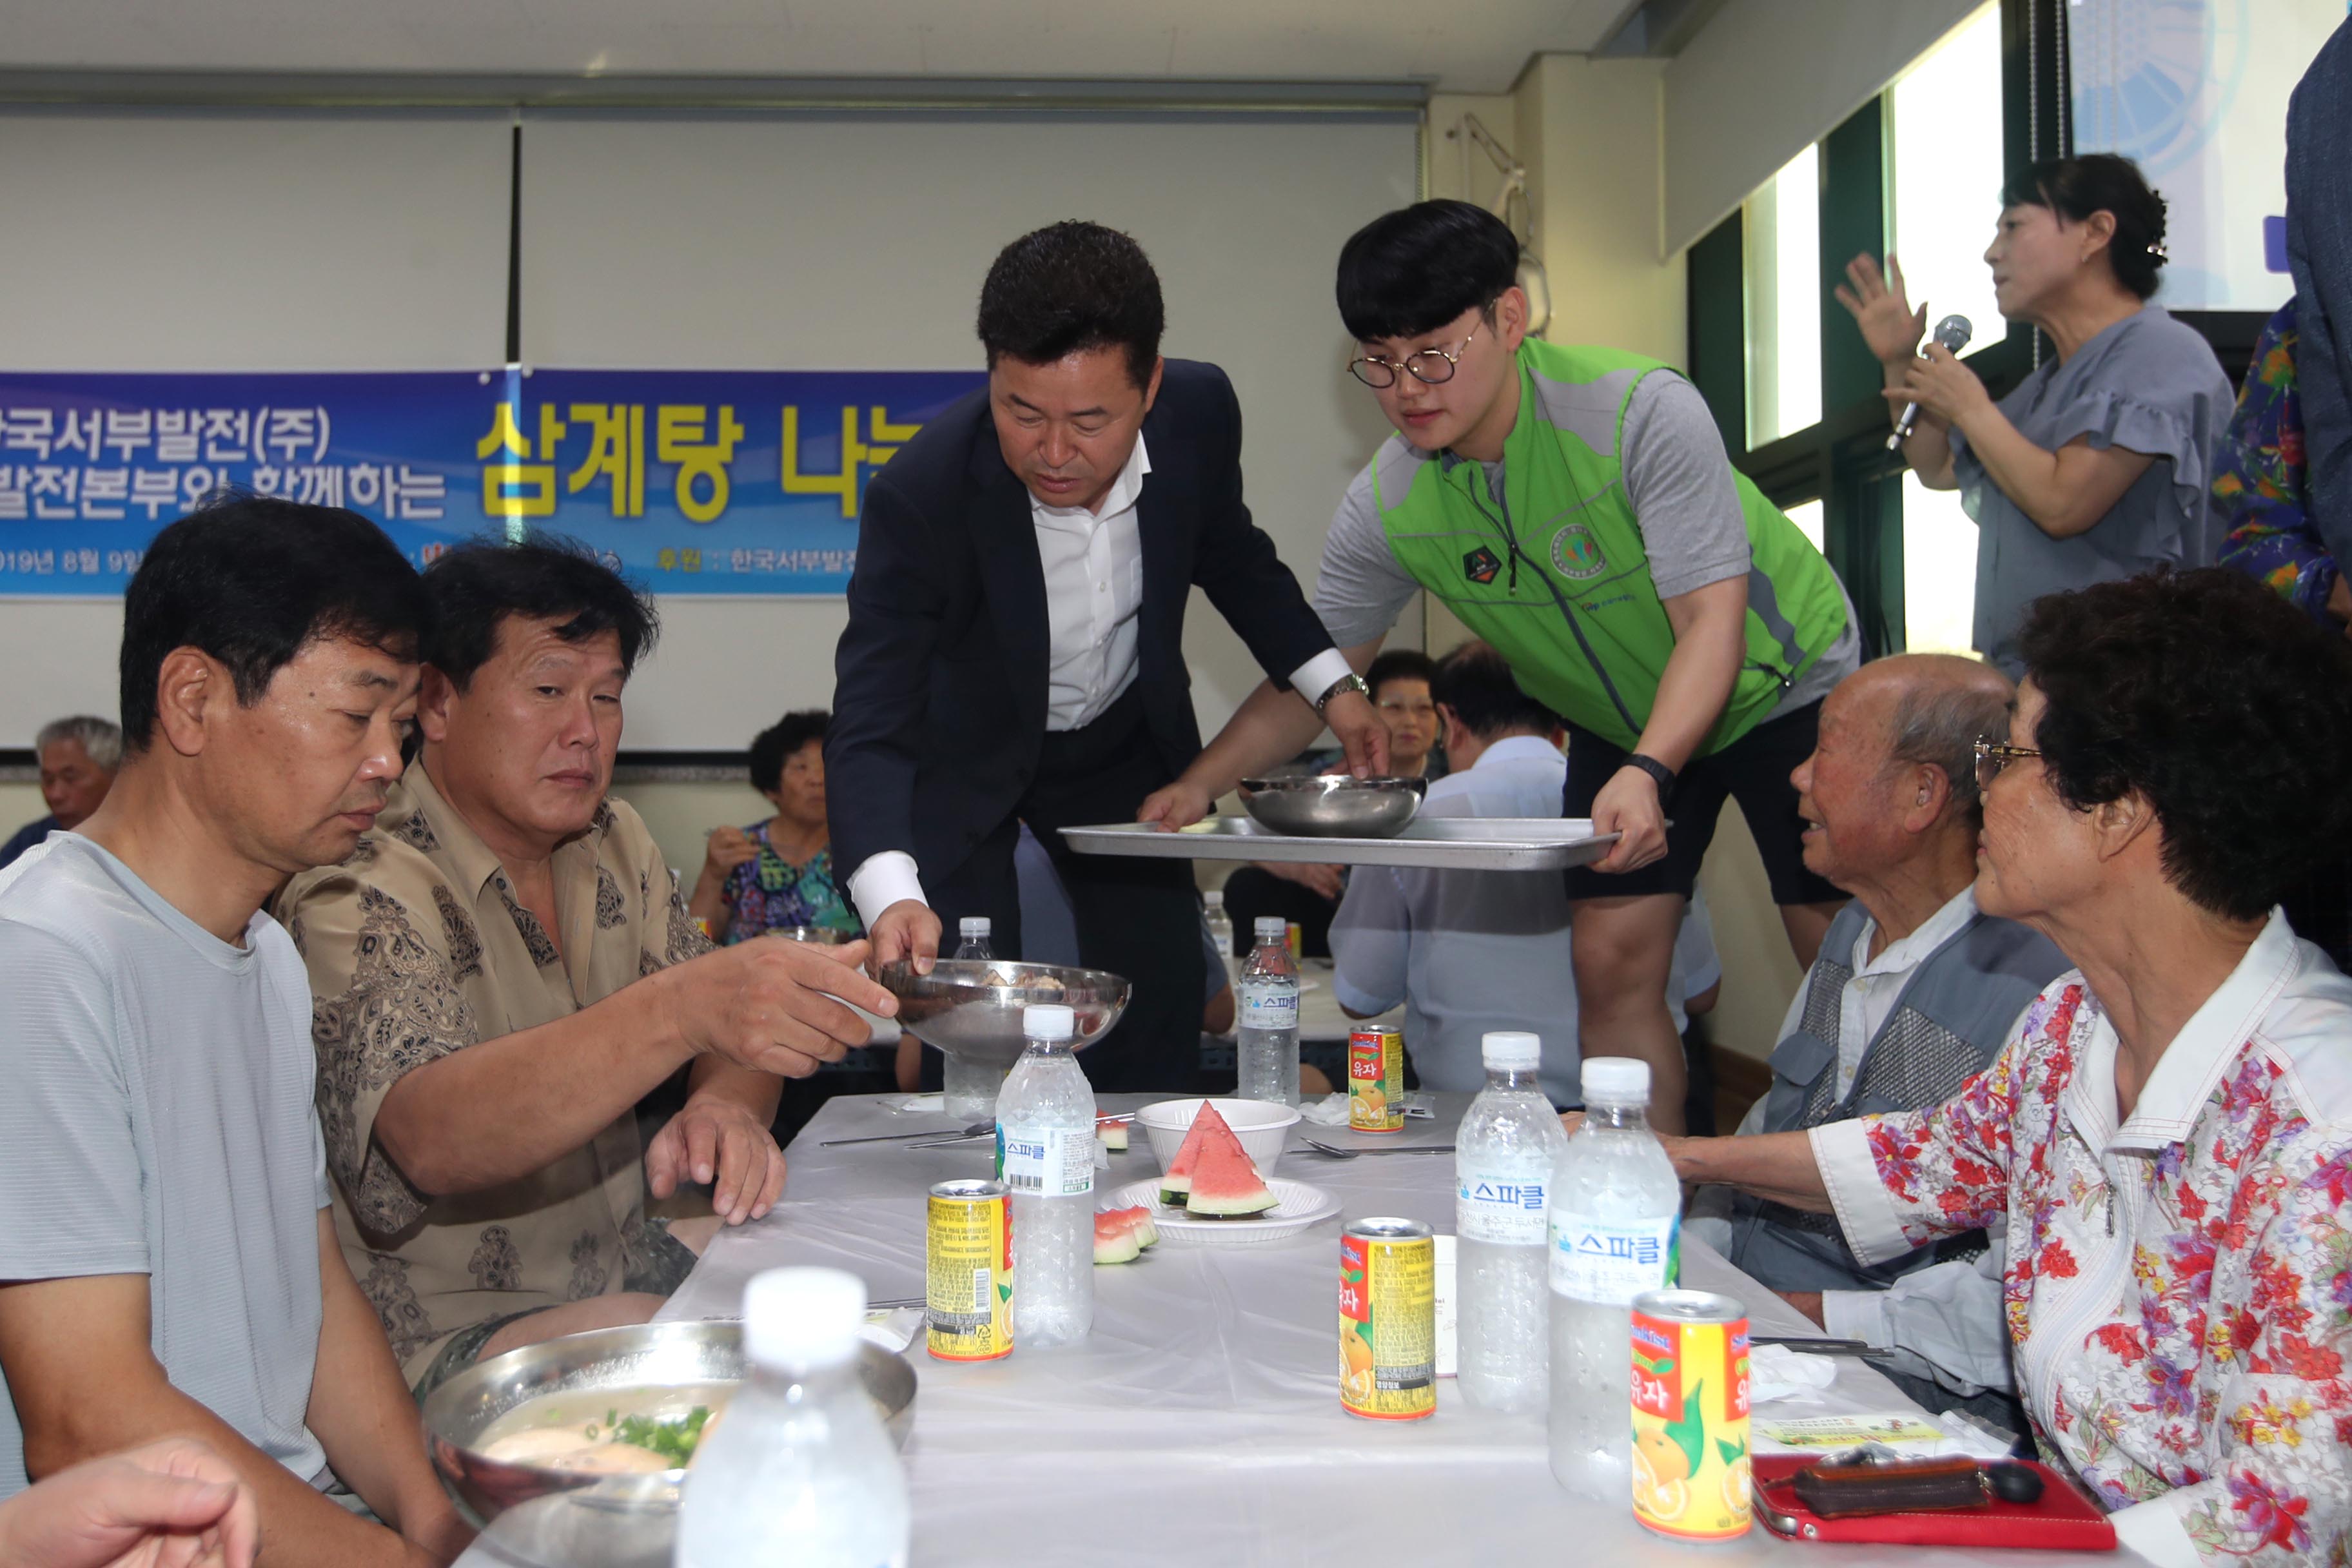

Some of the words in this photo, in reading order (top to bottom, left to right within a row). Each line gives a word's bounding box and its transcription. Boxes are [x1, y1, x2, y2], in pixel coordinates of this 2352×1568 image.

[0, 406, 330, 462] 국서부발전(주)
[476, 403, 745, 524] 삼계탕
[253, 462, 446, 518] 함께하는
[657, 547, 701, 573] 후원
[1353, 1061, 1377, 1077] 유자
[1006, 1142, 1046, 1160] 스파클
[1473, 1182, 1545, 1210] 스파클
[1576, 1233, 1661, 1265] 스파클
[1631, 1368, 1669, 1411] 유자
